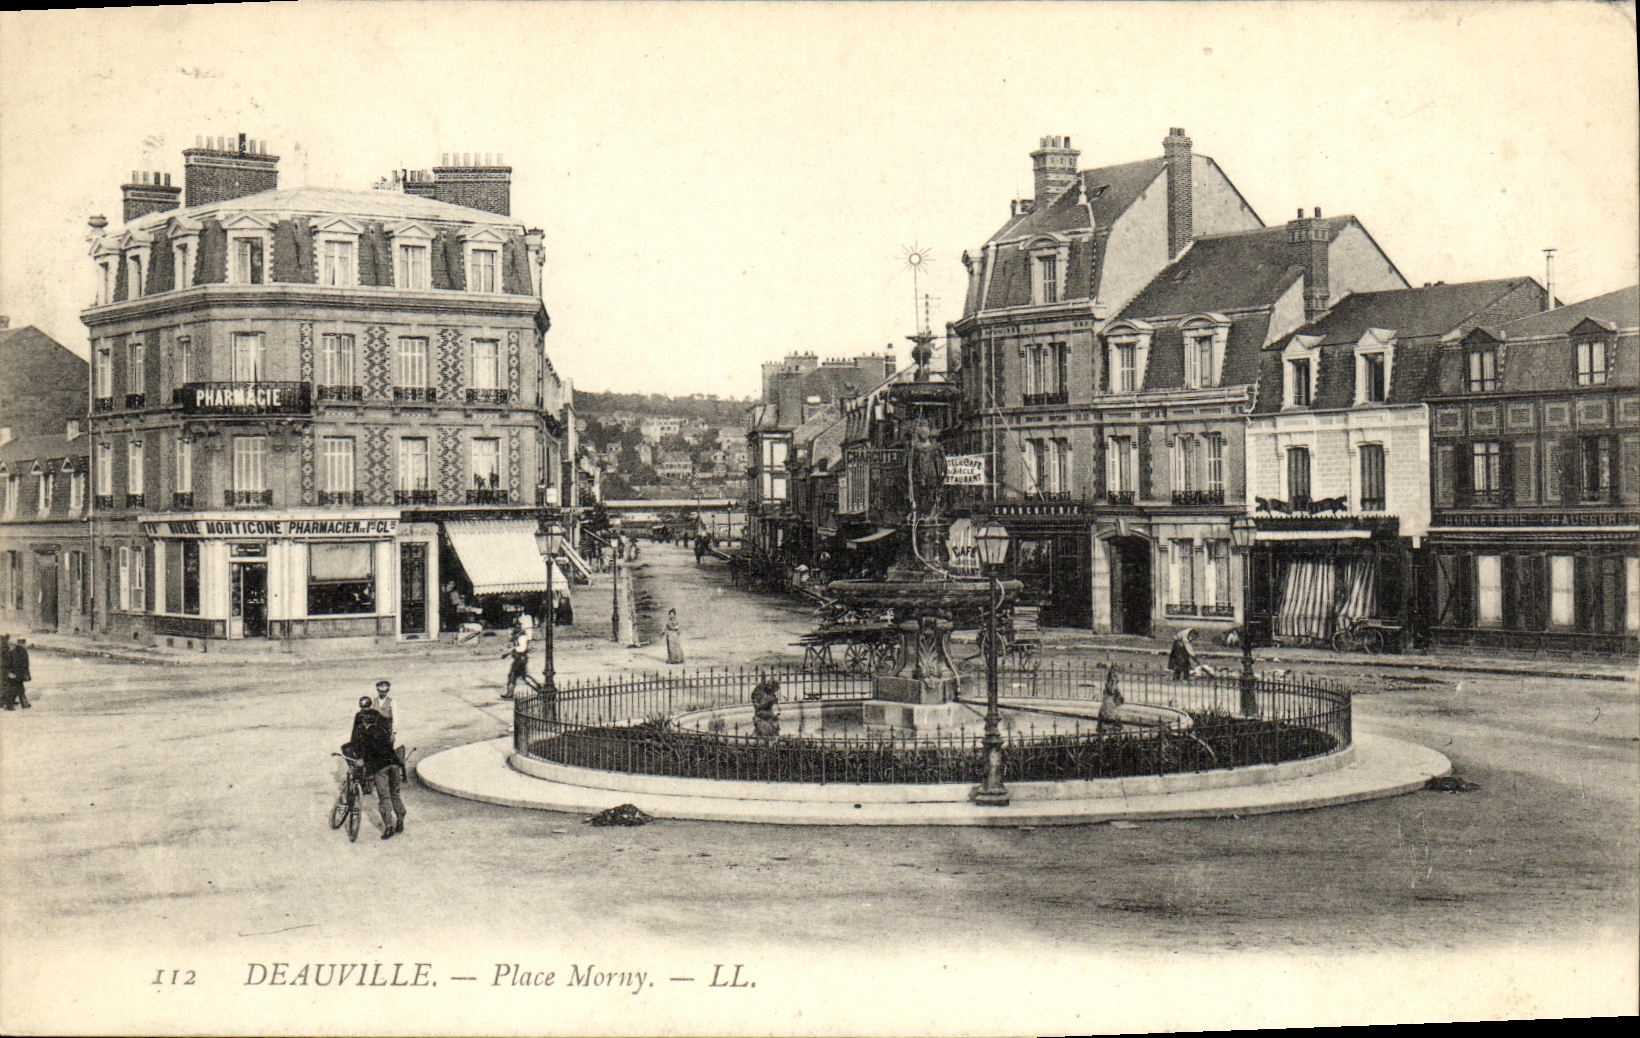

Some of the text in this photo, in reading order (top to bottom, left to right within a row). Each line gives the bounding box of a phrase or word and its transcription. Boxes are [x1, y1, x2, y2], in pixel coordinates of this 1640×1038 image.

[196, 388, 281, 407] PHARMACIE
[944, 473, 982, 483] STAURANT
[994, 506, 1079, 515] CHARCUTERIE
[206, 521, 283, 535] MONTICONE
[289, 520, 361, 534] PHARMACIEN
